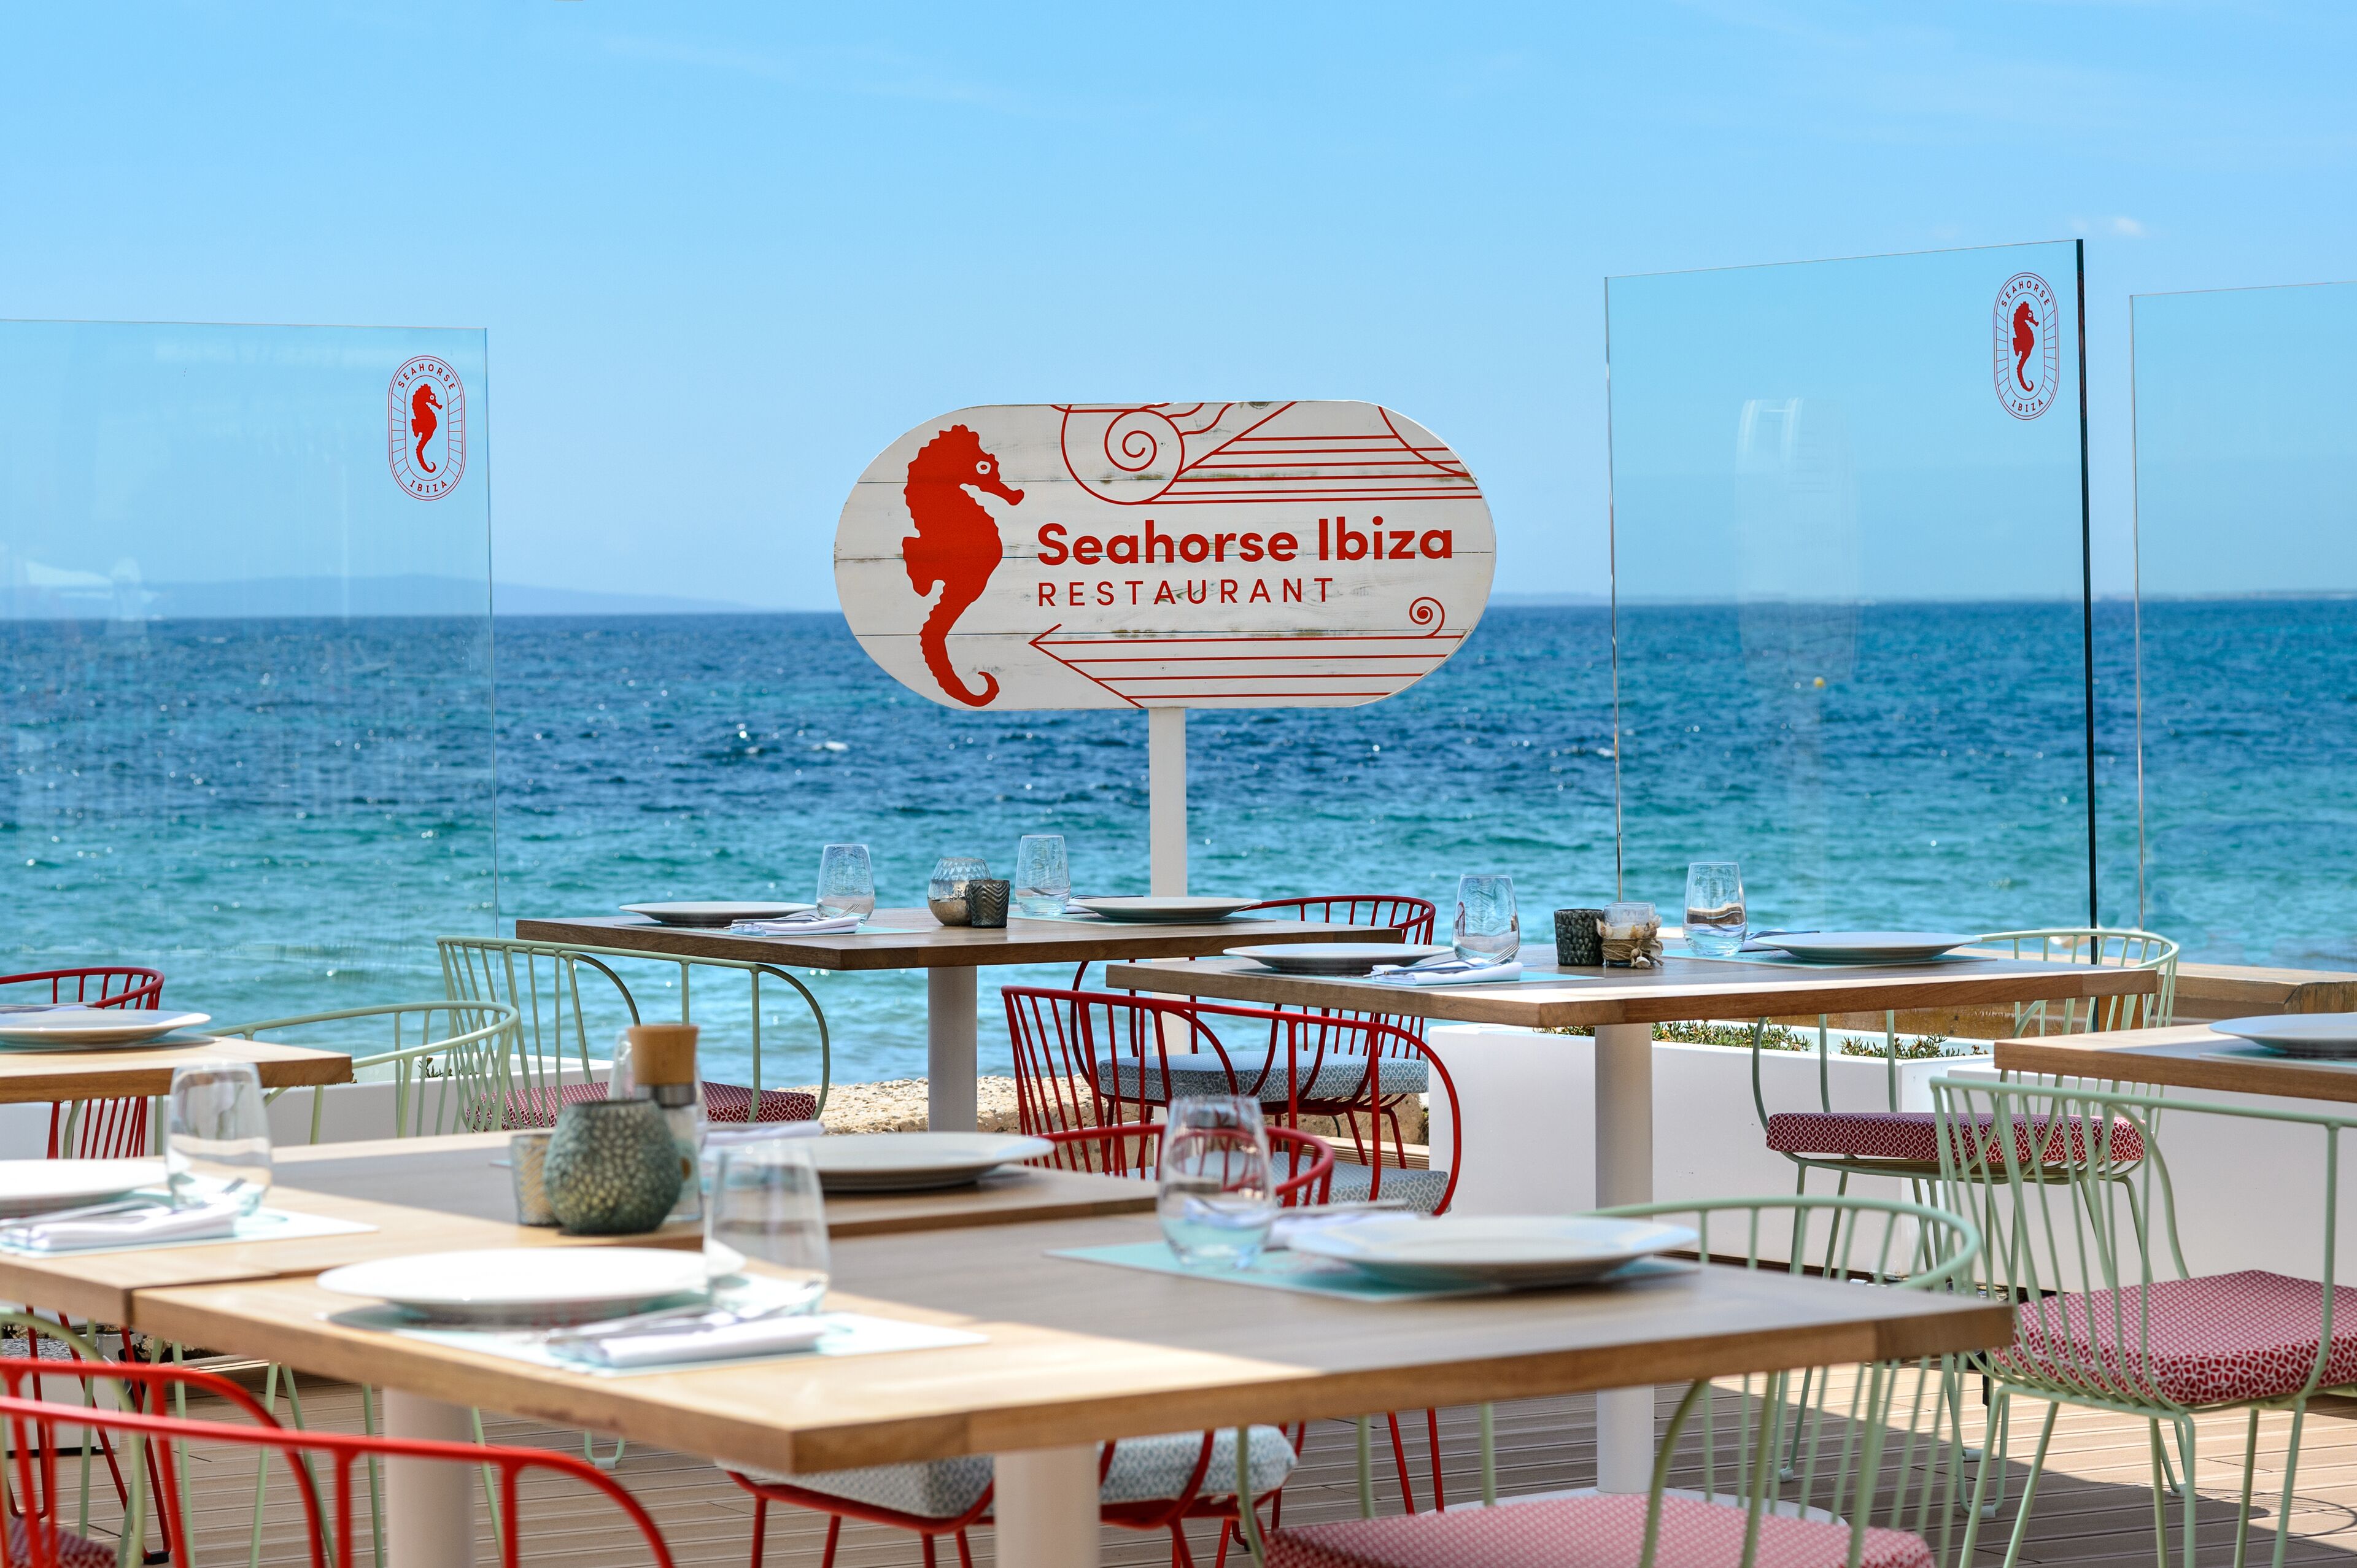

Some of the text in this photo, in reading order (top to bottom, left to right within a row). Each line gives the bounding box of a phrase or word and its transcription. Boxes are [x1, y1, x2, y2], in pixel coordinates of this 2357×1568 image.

[2001, 280, 2050, 307] SEAHORSE
[398, 363, 455, 390] SEAHORSE
[2011, 398, 2043, 412] IBIZA
[409, 480, 447, 493] IBIZA
[1038, 516, 1452, 566] Seahorse Ibiza
[1039, 577, 1333, 607] RESTAURANT
